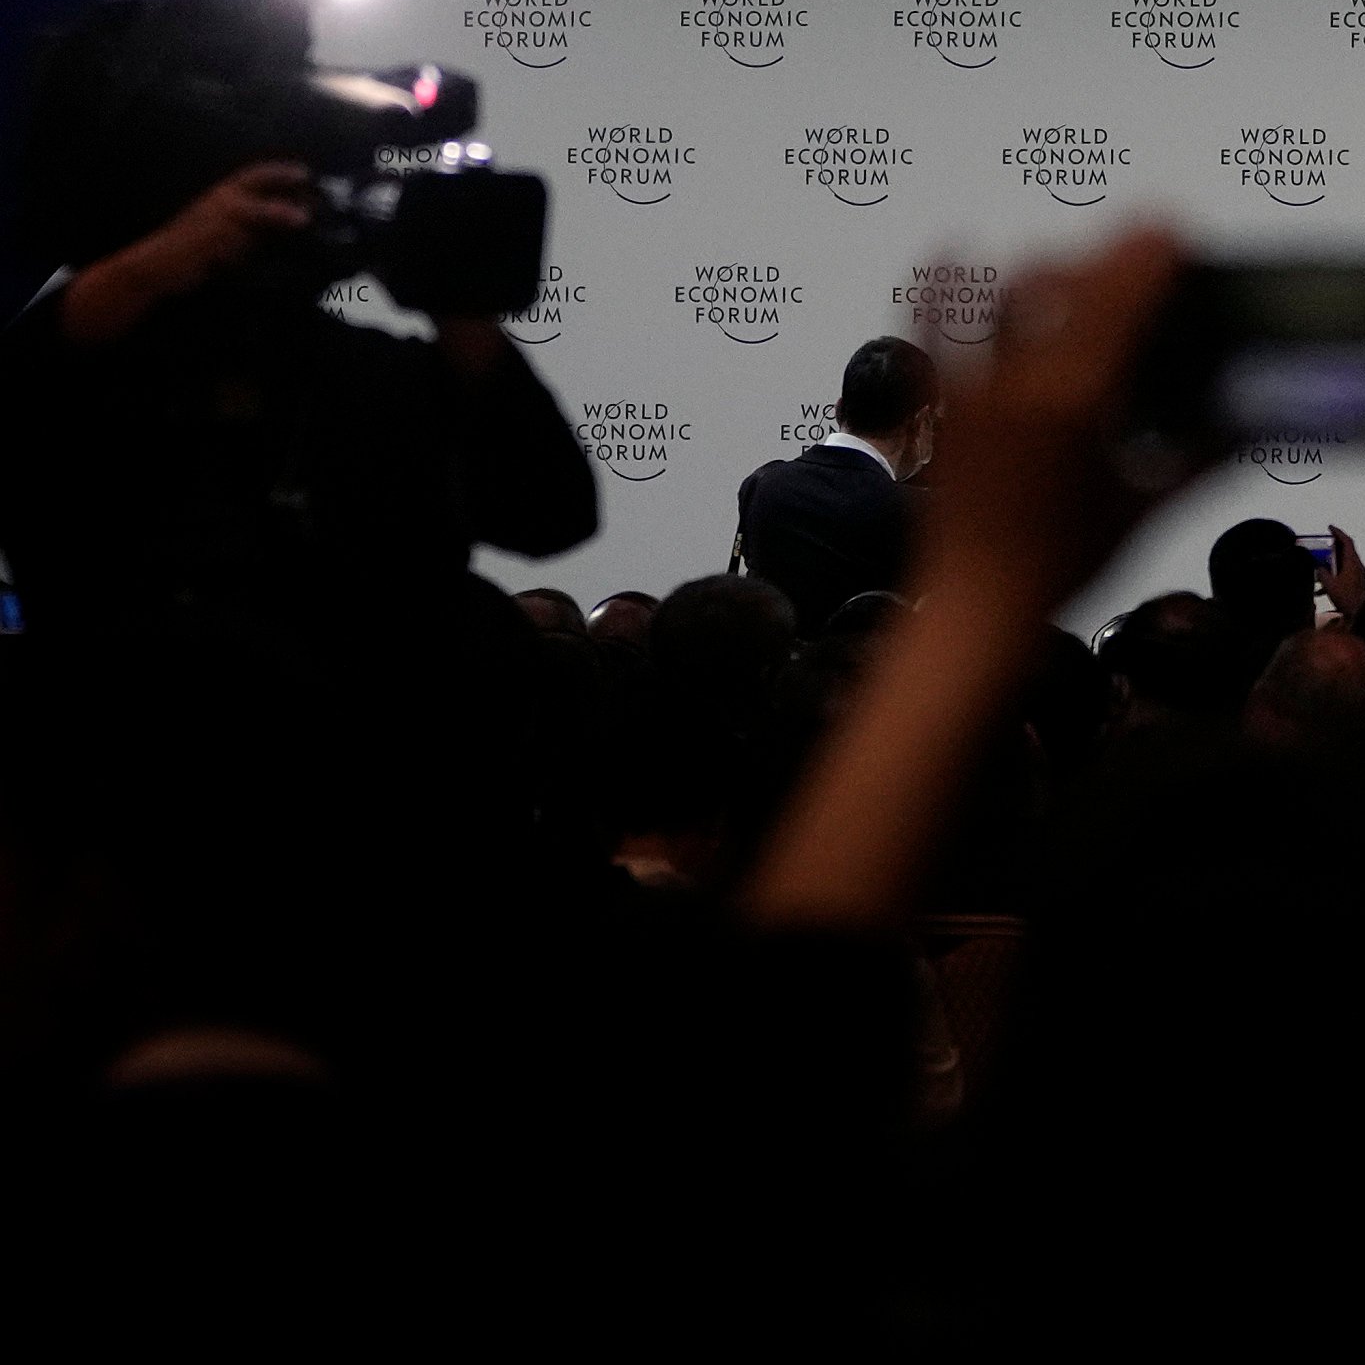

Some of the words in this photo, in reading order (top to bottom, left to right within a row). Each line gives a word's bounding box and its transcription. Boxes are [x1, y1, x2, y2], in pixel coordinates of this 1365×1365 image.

[680, 10, 809, 27] ECONOMIC
[1111, 10, 1240, 29] ECONOMIC
[701, 30, 785, 48] FORUM
[1132, 31, 1216, 49] FORUM
[587, 127, 673, 144] WORLD
[804, 127, 890, 145] WORLD
[1240, 128, 1327, 146] WORLD
[567, 147, 696, 165] ECONOMIC
[784, 147, 913, 166] ECONOMIC
[1220, 148, 1350, 166] ECONOMIC
[588, 168, 672, 185] FORUM
[805, 168, 889, 186] FORUM
[1241, 169, 1326, 187] FORUM
[694, 265, 780, 283] WORLD
[674, 285, 803, 304] ECONOMIC
[695, 306, 780, 324] FORUM
[1238, 447, 1323, 464] FORUM
